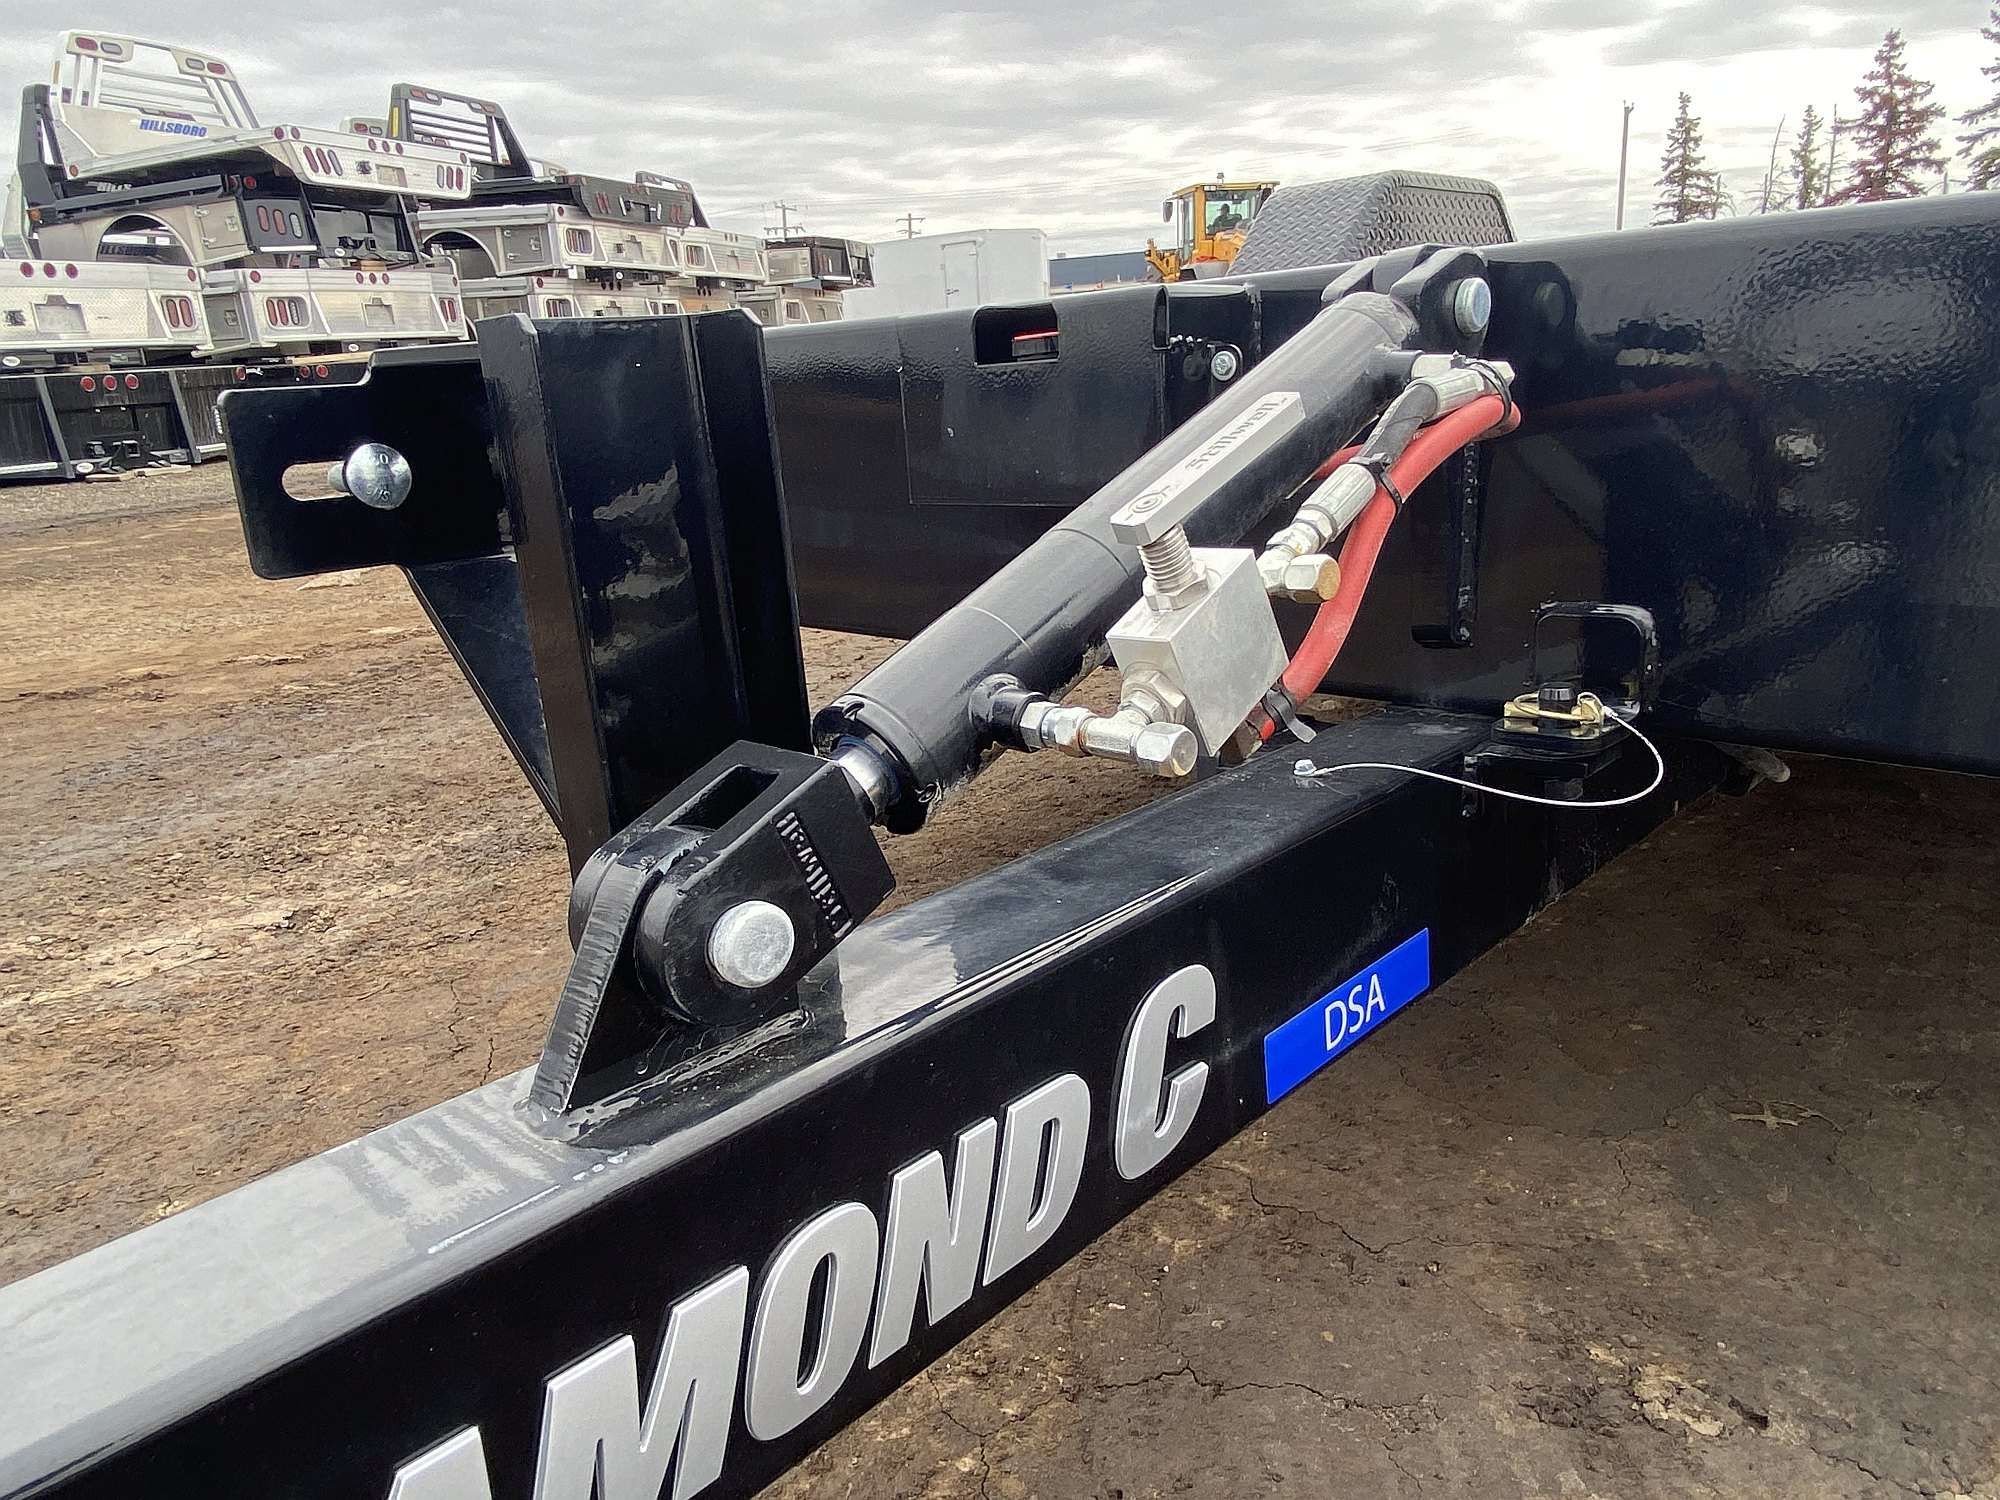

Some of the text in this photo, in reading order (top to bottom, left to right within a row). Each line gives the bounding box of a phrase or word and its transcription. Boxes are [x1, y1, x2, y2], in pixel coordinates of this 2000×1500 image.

[140, 119, 207, 138] HILLSBORO
[1324, 973, 1387, 1052] DSA
[1114, 963, 1217, 1181] C
